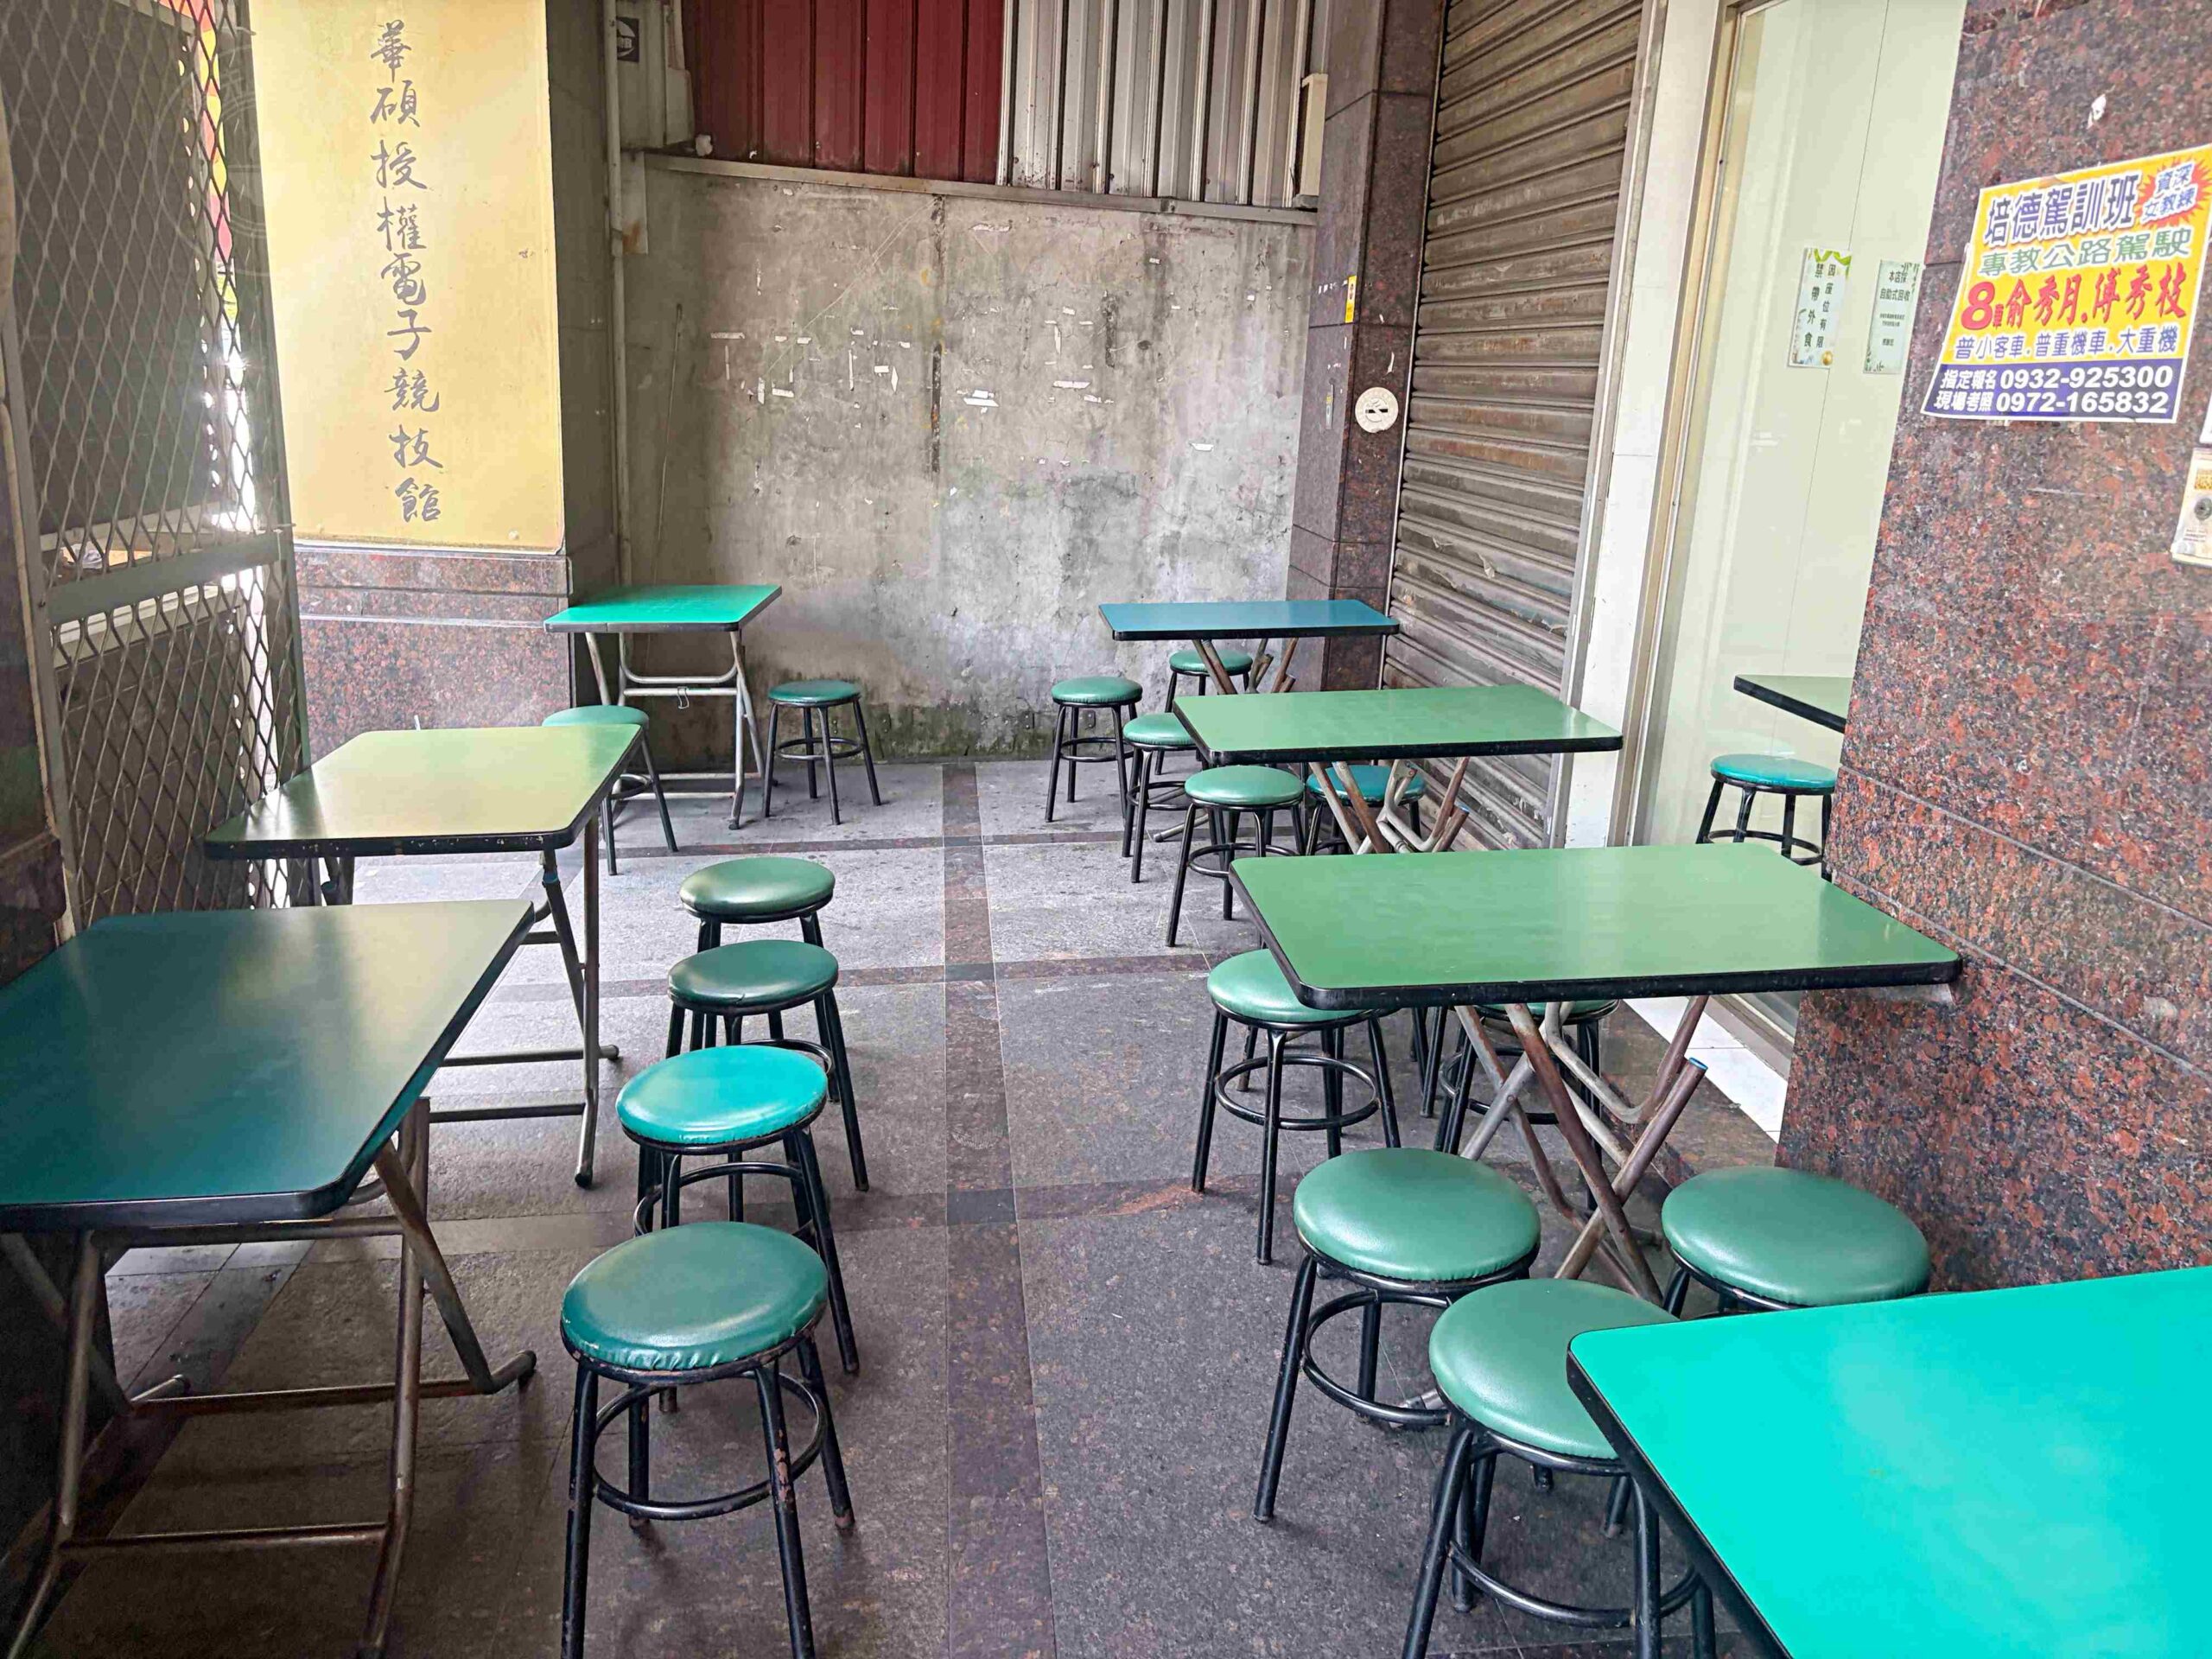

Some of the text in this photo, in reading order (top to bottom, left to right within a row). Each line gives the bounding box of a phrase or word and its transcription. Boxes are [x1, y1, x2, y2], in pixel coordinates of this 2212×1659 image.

[1985, 174, 2139, 244] 培德駕訓班
[370, 19, 443, 522] 華碩授權電子競技館
[1979, 227, 2191, 276] 專教公路駕駛
[1934, 391, 2169, 413] 現場考照 0972-165832
[1940, 365, 2173, 390] 指定報名 0932-925300
